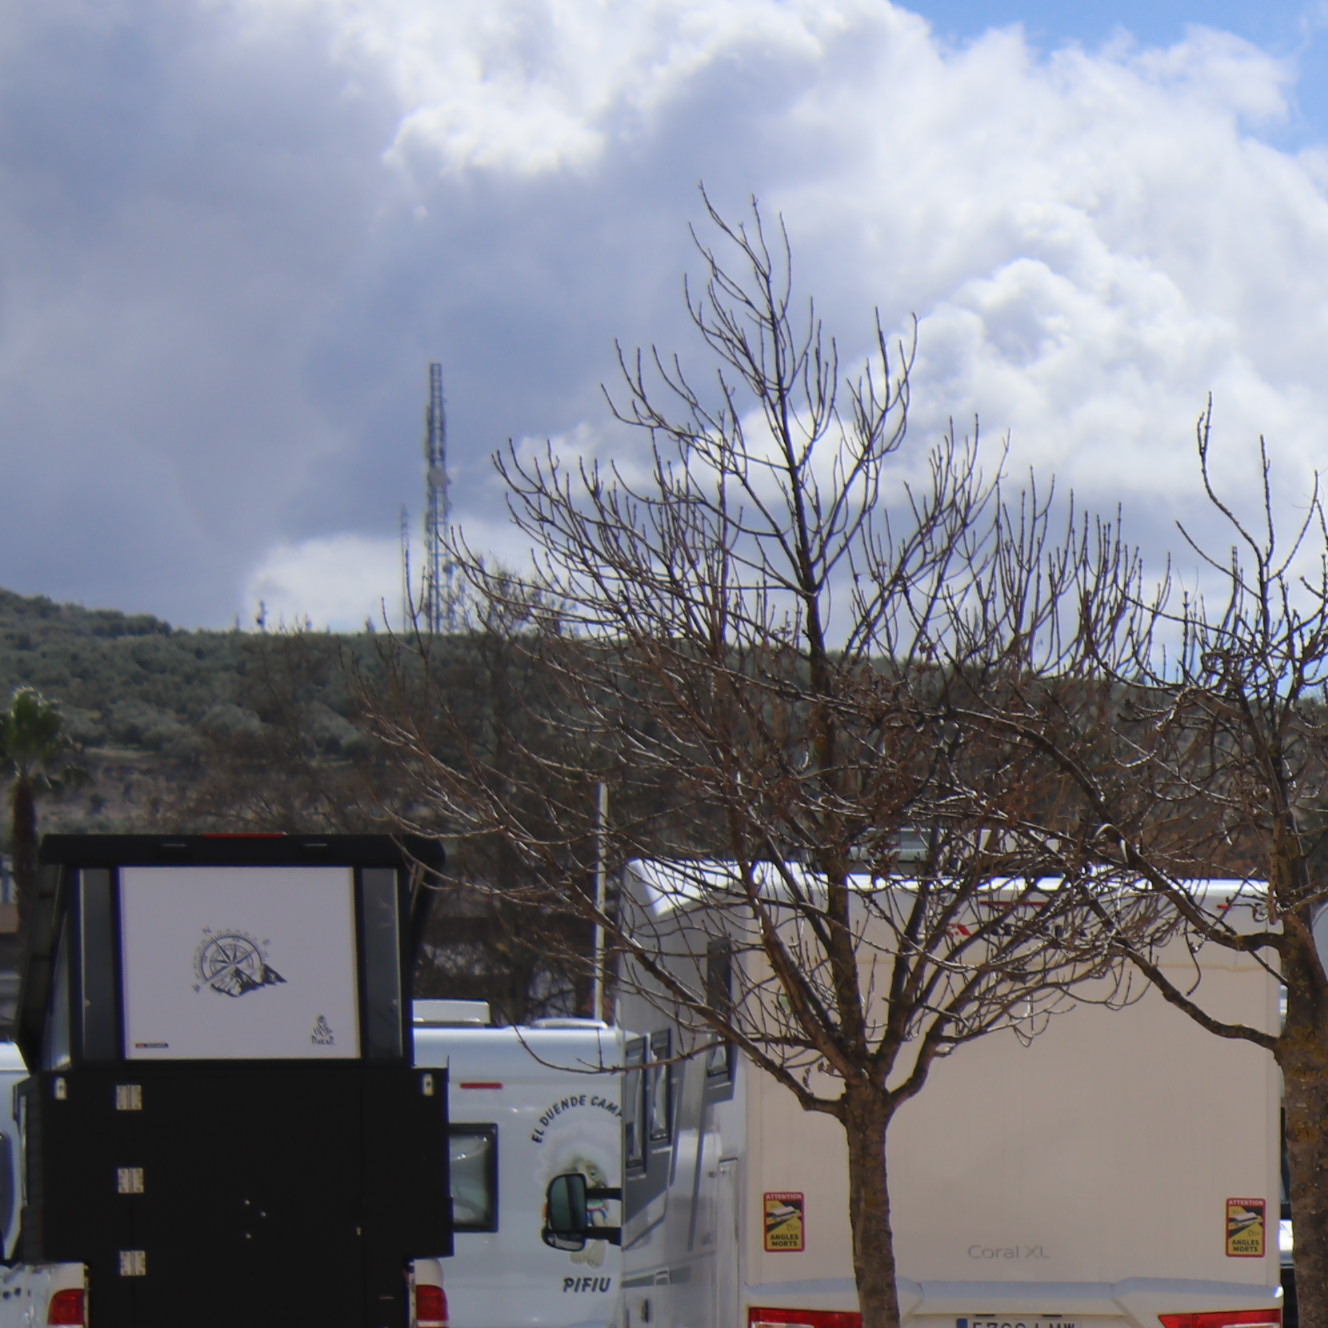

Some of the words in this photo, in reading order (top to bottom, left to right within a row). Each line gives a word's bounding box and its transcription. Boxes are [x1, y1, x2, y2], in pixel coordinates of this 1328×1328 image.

[531, 1128, 545, 1144] EL
[539, 1094, 587, 1127] DUENDE
[968, 1244, 1020, 1259] Coral
[1024, 1245, 1050, 1259] XL
[563, 1277, 612, 1293] PIFIU
